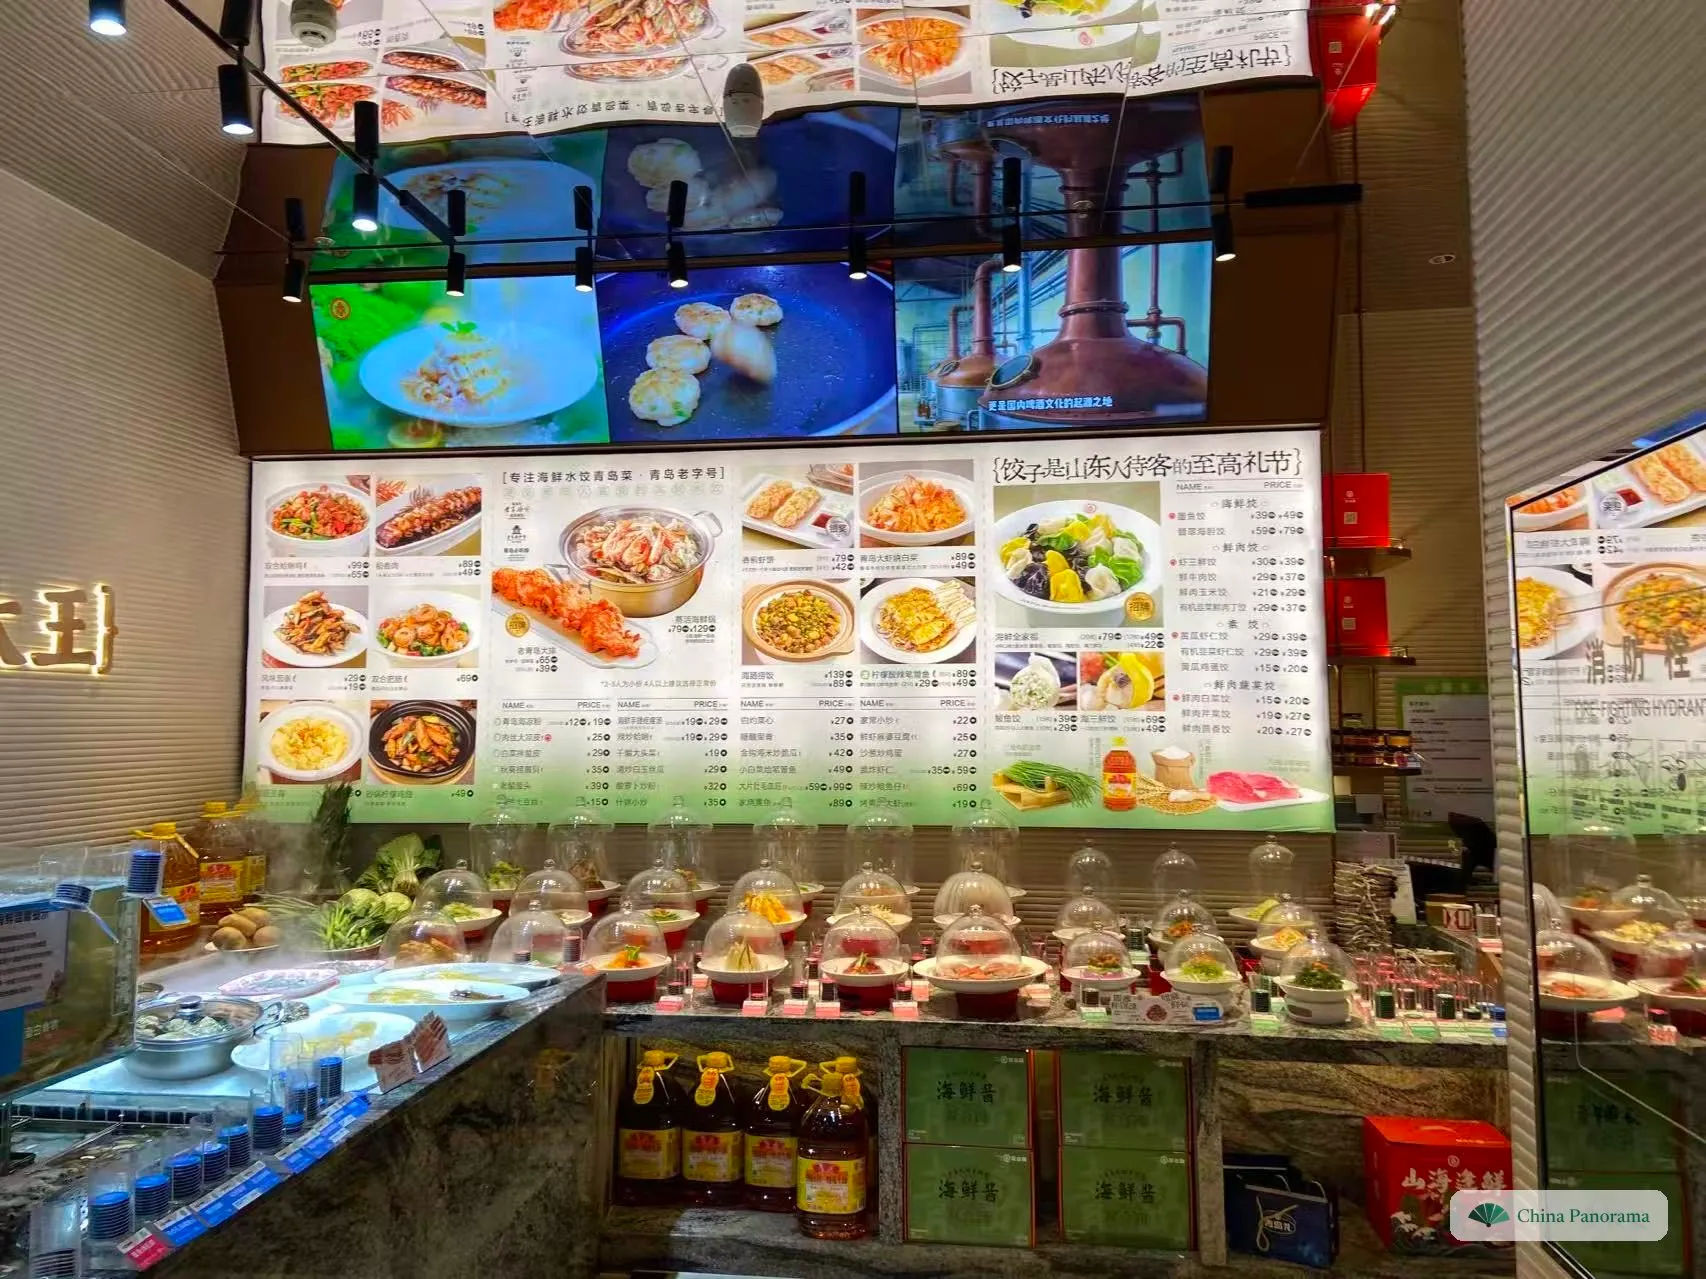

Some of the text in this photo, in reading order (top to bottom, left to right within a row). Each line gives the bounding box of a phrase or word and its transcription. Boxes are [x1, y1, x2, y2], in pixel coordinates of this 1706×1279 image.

[988, 396, 1113, 411] 更是国内啤酒文化的起源之地
[1176, 481, 1292, 491] NAME PRICE
[577, 701, 601, 709] PRICE
[694, 700, 718, 708] PRICE
[818, 699, 844, 707] PRICE
[860, 699, 884, 707] NAME
[936, 1079, 997, 1104] 海鲜酱
[1093, 1082, 1154, 1106] 海鲜酱
[938, 1178, 999, 1202] 海鲜酱
[1095, 1180, 1157, 1204] 海鲜酱
